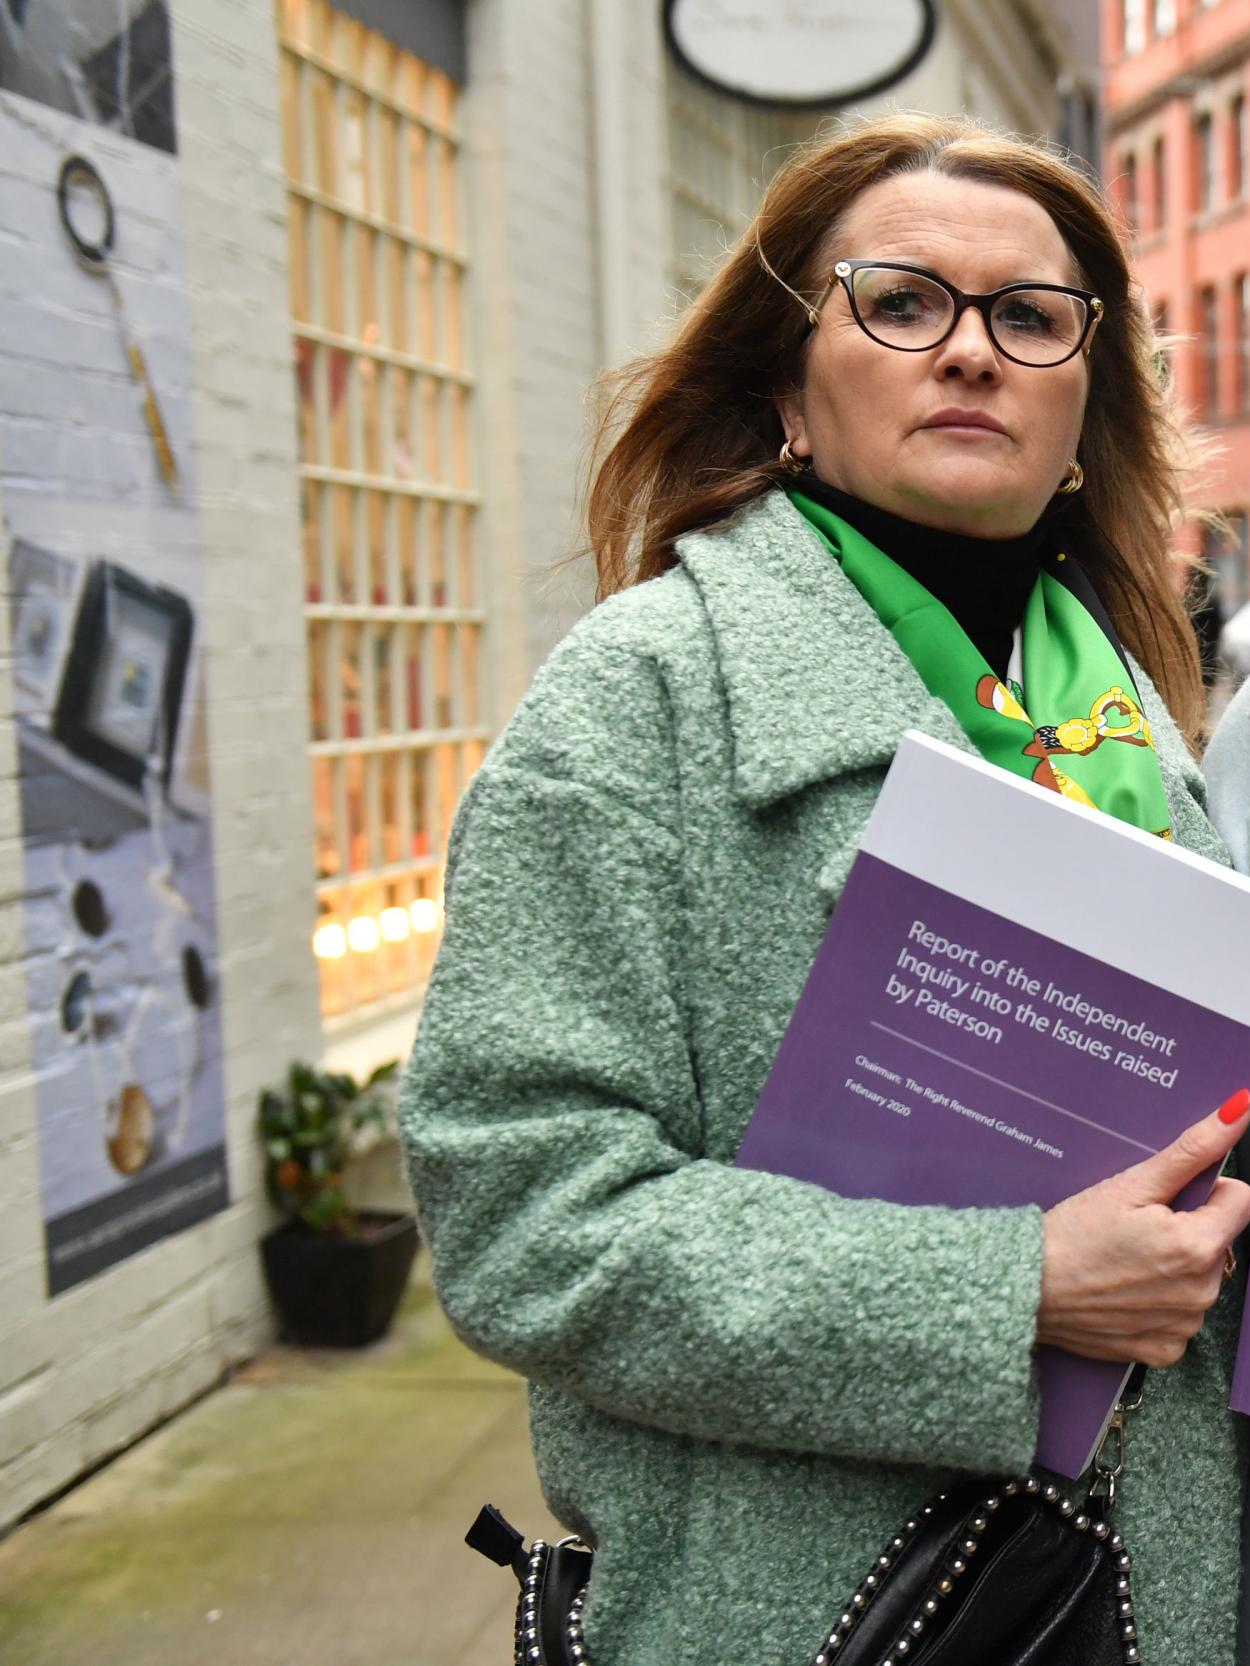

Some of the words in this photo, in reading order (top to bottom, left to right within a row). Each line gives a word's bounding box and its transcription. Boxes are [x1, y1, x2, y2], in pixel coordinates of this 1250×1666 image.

[885, 974, 913, 1005] by
[914, 988, 1002, 1045] Paterson
[896, 948, 969, 998] Inquiry
[970, 981, 1012, 1015] into
[1015, 1002, 1050, 1033] the
[1051, 1018, 1113, 1060] Issues
[1114, 1050, 1179, 1089] raised
[908, 920, 979, 969] Report
[981, 958, 1008, 977] of
[1007, 967, 1041, 996] the
[1043, 982, 1177, 1057] Independent
[844, 1078, 887, 1106] February
[886, 1099, 912, 1117] 2020
[855, 1055, 902, 1084] Chairman:
[905, 1078, 923, 1094] The
[923, 1087, 950, 1107] Right
[949, 1099, 996, 1128] Reverend
[995, 1120, 1033, 1145] Graham
[1033, 1138, 1064, 1158] James
